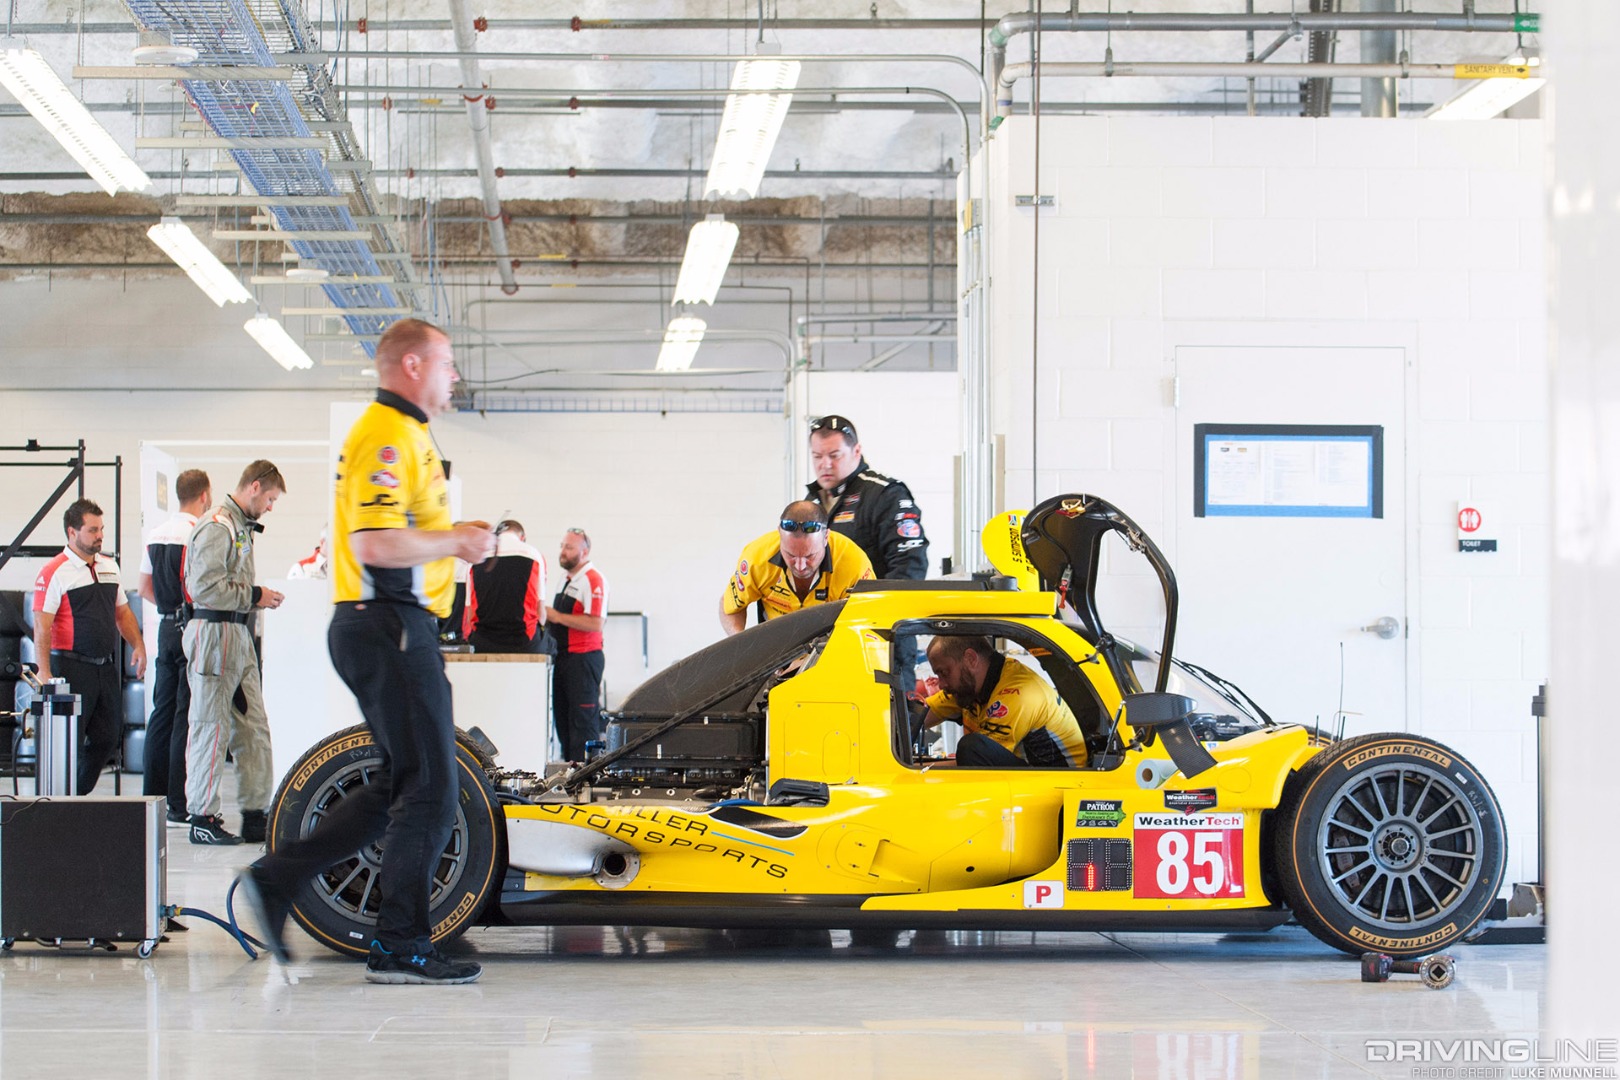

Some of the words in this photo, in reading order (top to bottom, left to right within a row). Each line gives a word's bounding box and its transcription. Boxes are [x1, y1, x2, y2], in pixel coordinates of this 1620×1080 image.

[1464, 65, 1496, 74] SANITARY
[1498, 65, 1515, 74] VENT
[1346, 744, 1449, 767] CONTINENTAL
[1086, 802, 1116, 811] PATRÓN
[609, 803, 709, 837] ILLER
[1139, 815, 1240, 827] WeatherTech
[1156, 831, 1225, 895] 85
[1036, 885, 1052, 904] P
[1353, 924, 1455, 949] CONTINENTAL
